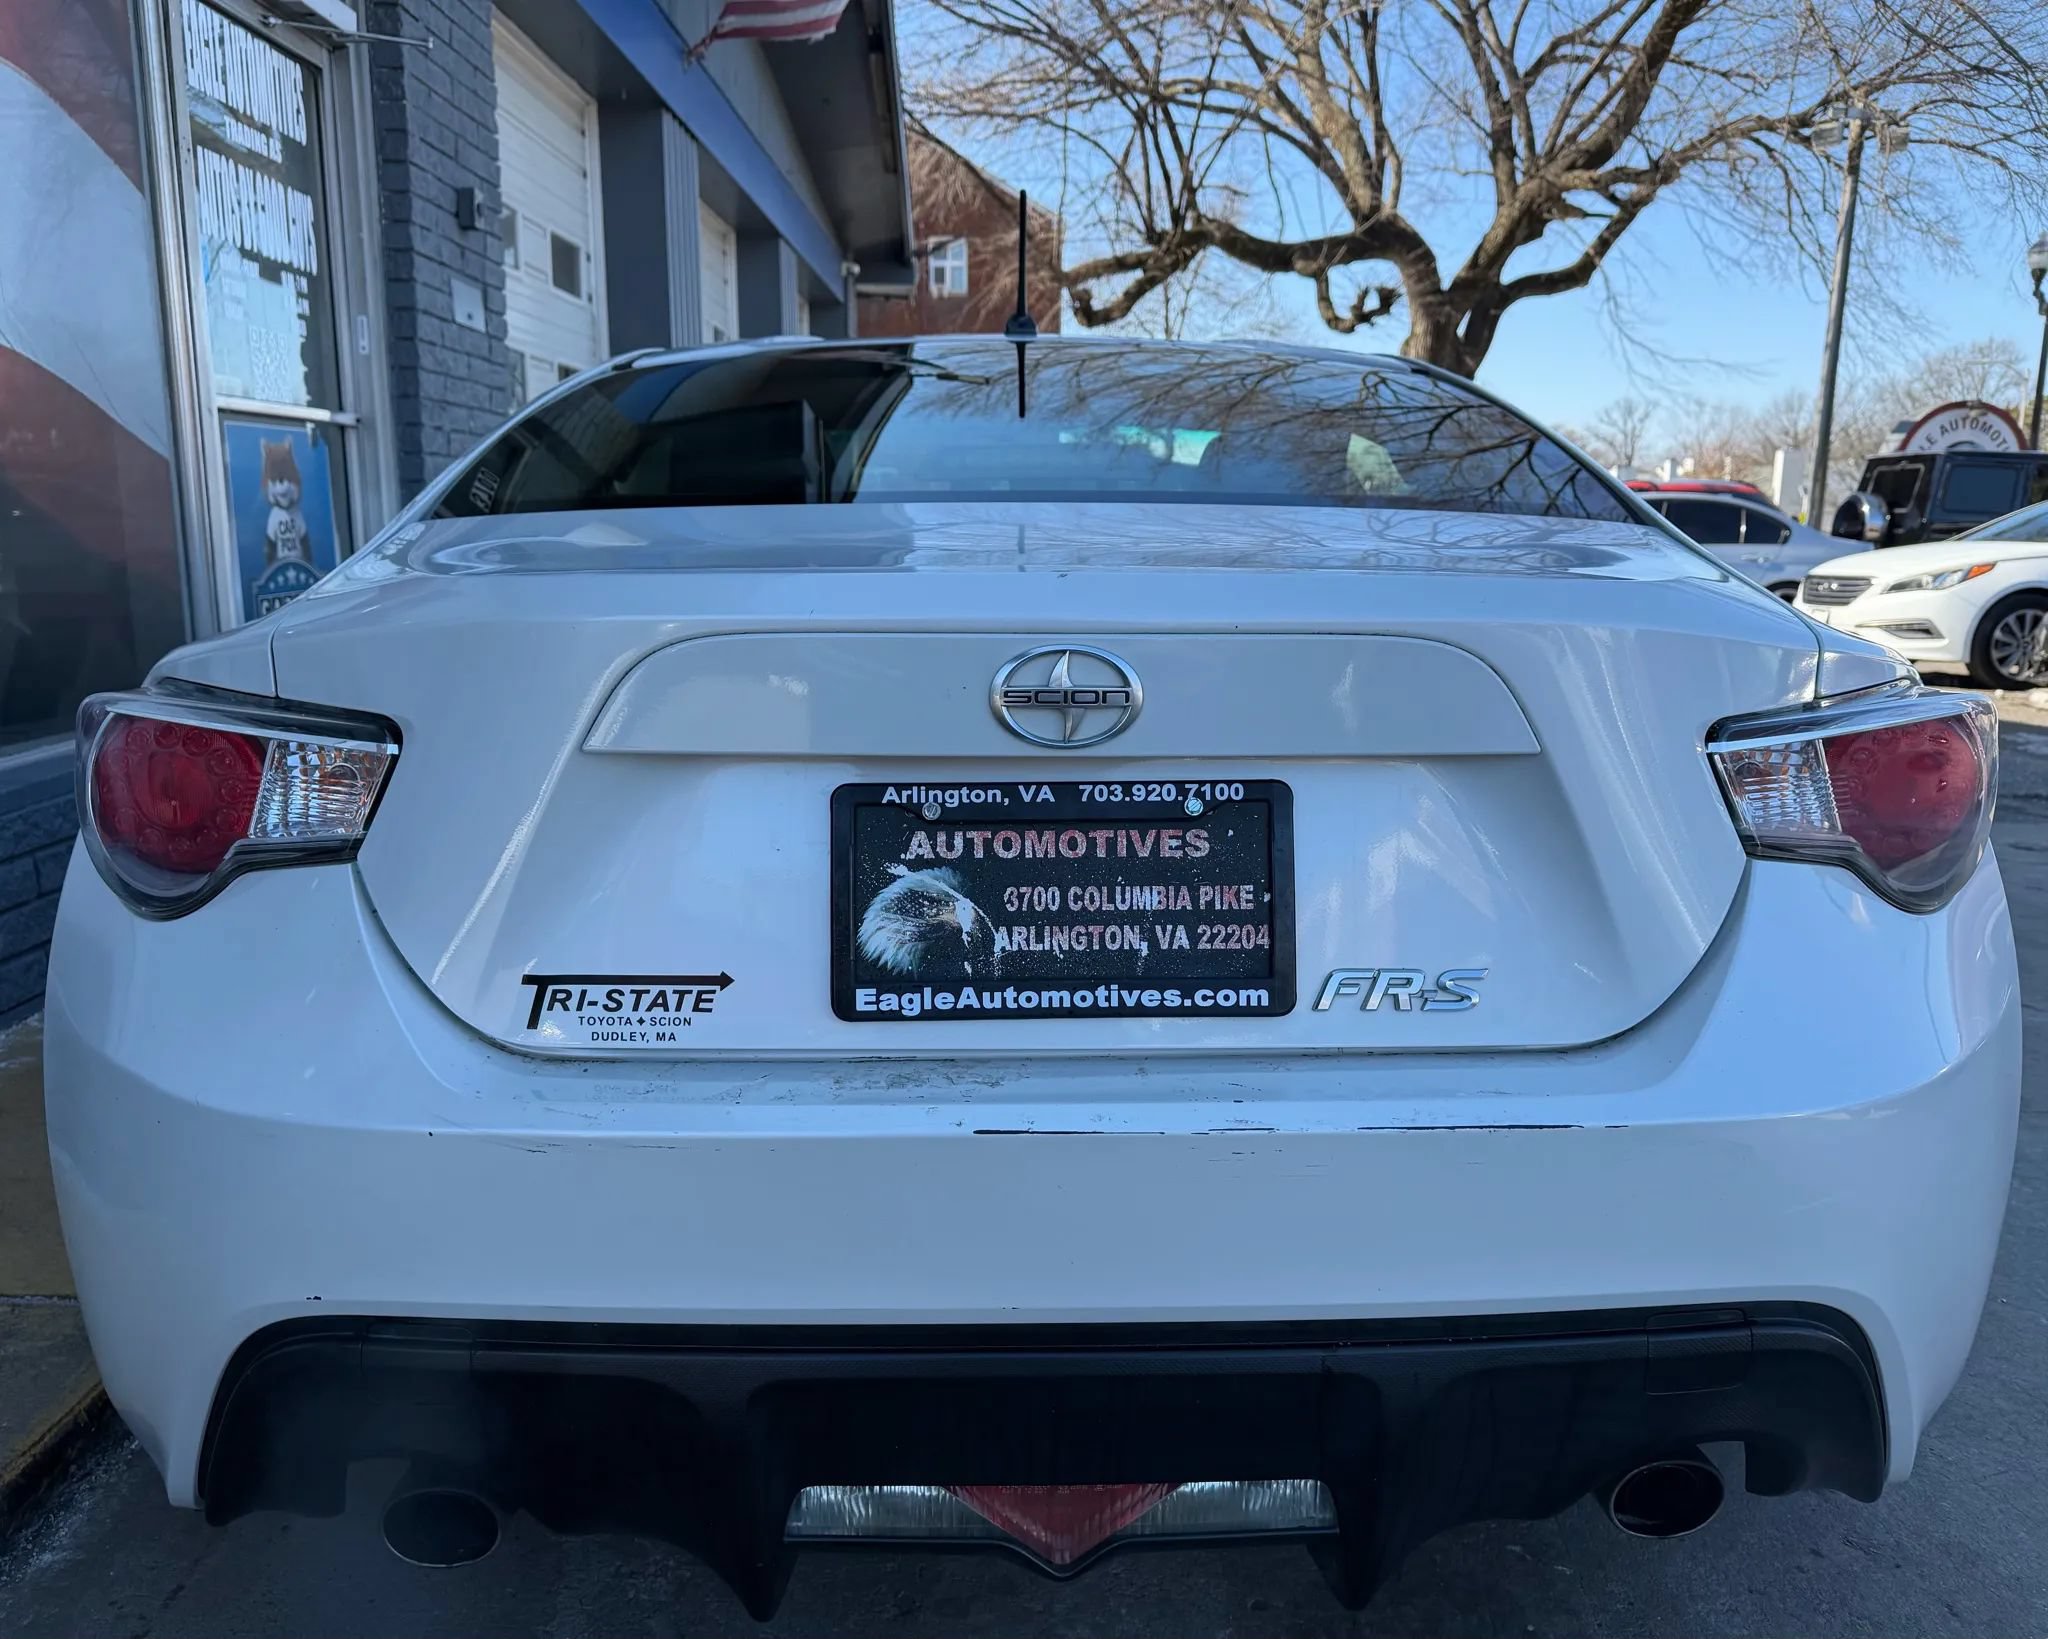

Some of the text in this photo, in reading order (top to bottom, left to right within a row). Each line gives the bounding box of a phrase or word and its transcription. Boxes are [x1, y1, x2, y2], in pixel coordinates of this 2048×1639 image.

[182, 0, 307, 147] EAGLE AUTOMOTIVES
[196, 144, 241, 249] AUTOS
[237, 162, 258, 253] BY
[881, 782, 1245, 808] Arlington, VA 703.920.7100
[905, 829, 1211, 859] AUTOMOTIVES
[1003, 884, 1255, 912] 3700 COLUMBIA PIKE
[1155, 925, 1191, 950] VA
[1197, 923, 1271, 951] 22204
[521, 973, 730, 1030] TRI-STATE
[854, 984, 1270, 1018] EagleAutomotives.com
[1311, 967, 1489, 1012] FR-S
[578, 1016, 692, 1027] TOYOTA SCION
[591, 1031, 677, 1044] DUDLEY, MA
